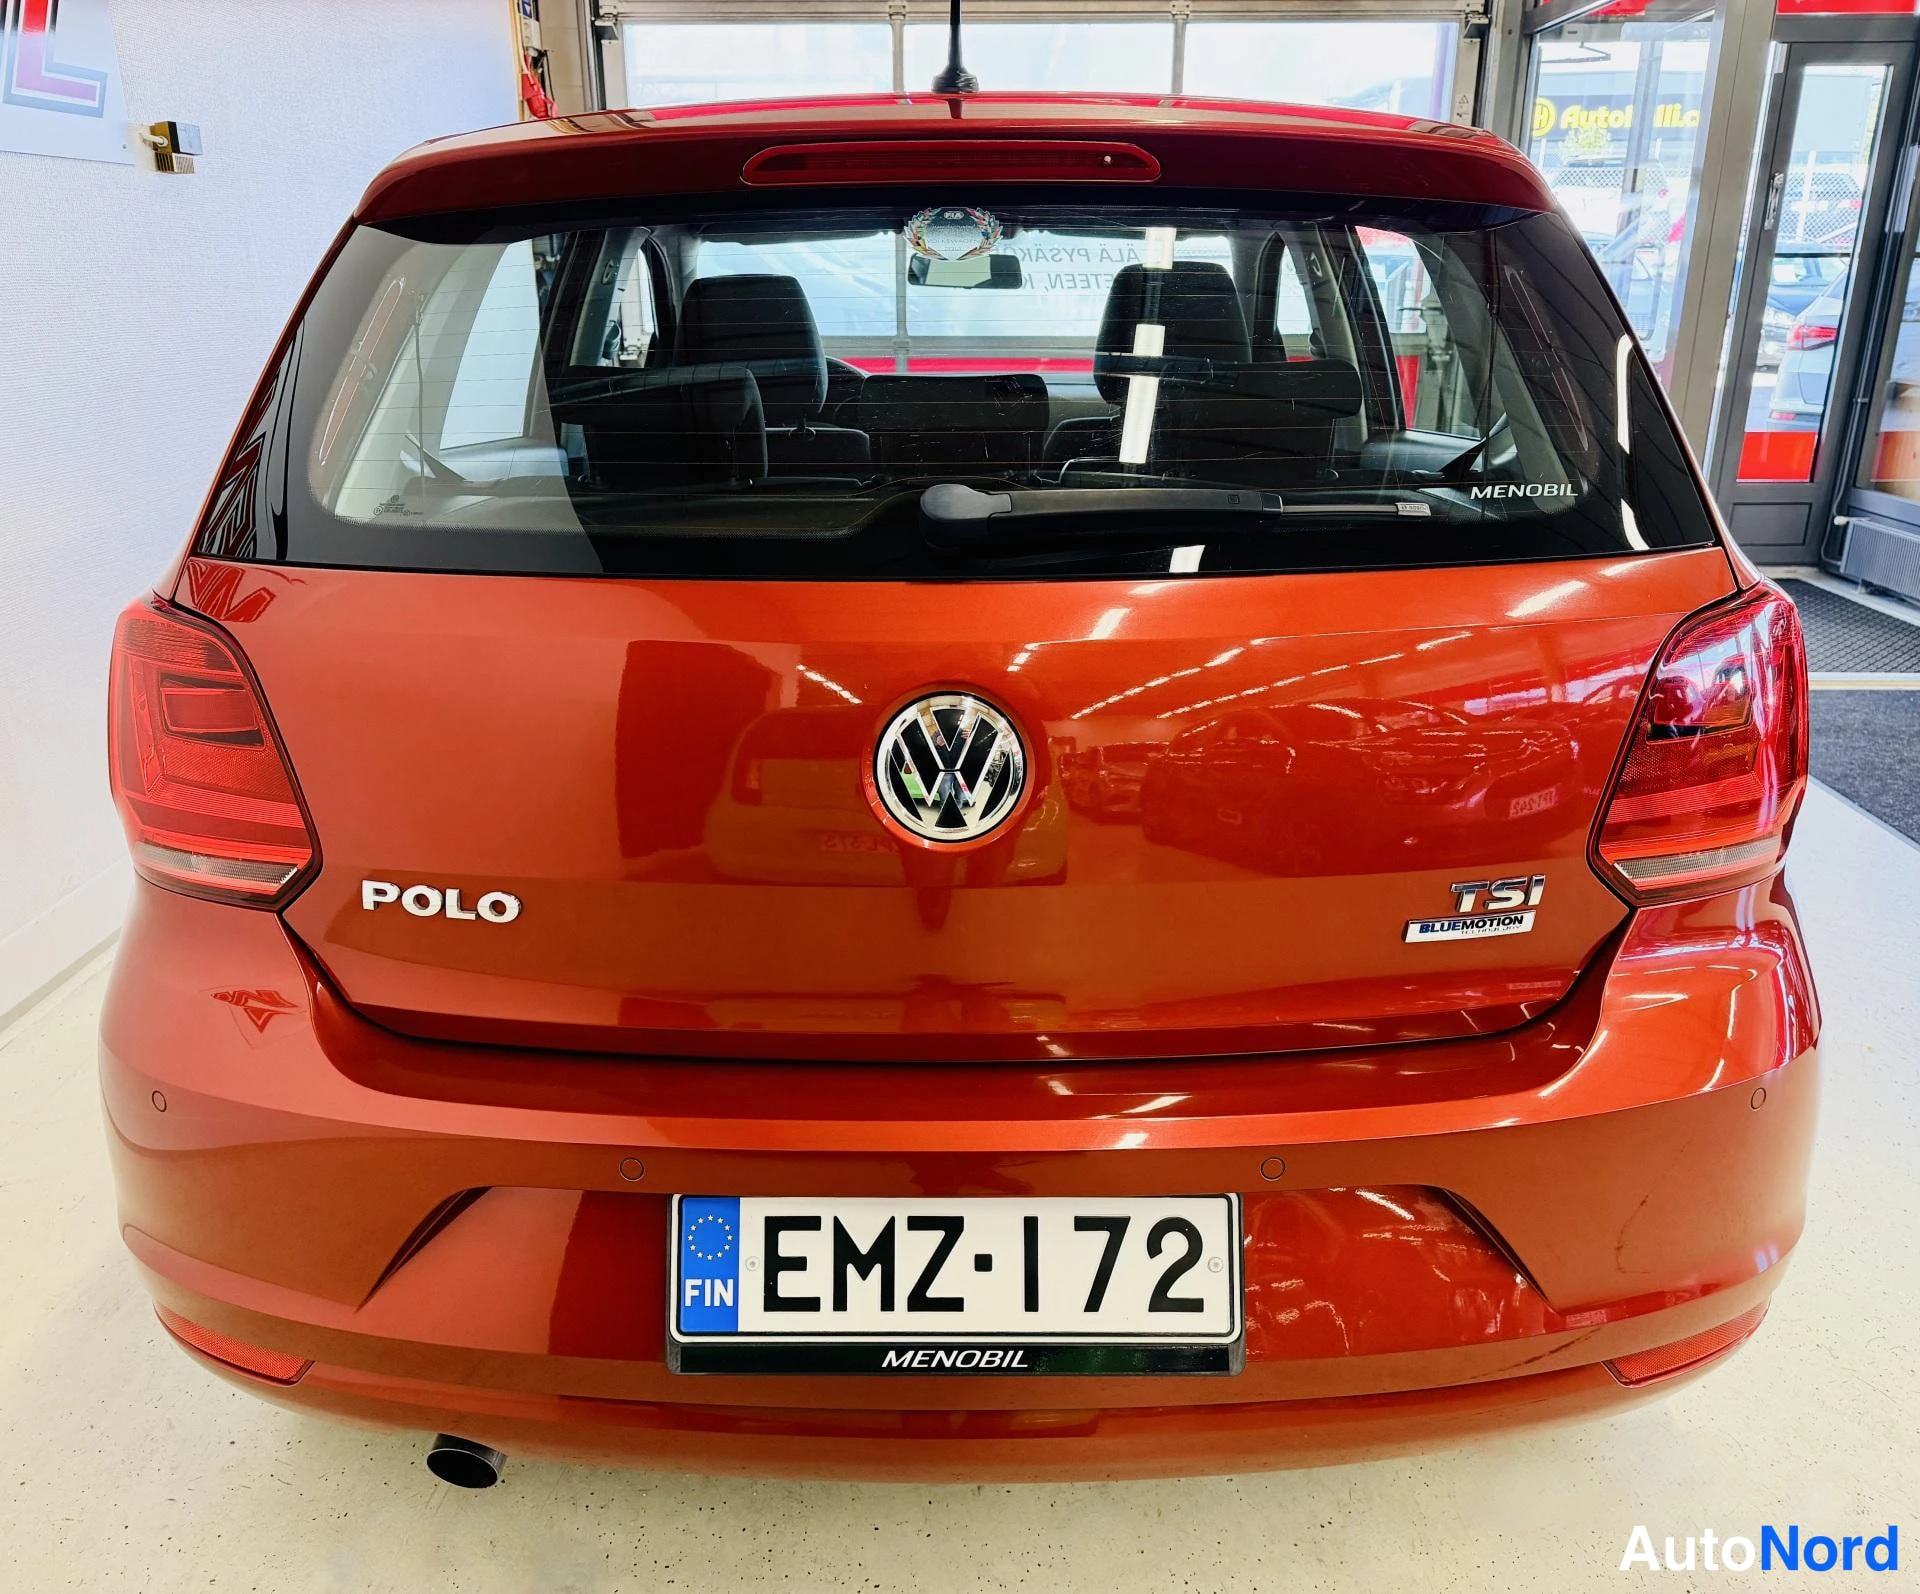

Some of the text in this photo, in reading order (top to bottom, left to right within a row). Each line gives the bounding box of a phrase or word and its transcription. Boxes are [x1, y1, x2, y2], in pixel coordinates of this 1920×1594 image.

[1470, 483, 1579, 500] MENOBIL
[361, 879, 524, 924] POLO
[1451, 874, 1546, 913] TSI
[1419, 914, 1524, 934] BLUEMOTION
[684, 1278, 734, 1307] FIN
[881, 1349, 1029, 1369] MENOBIL
